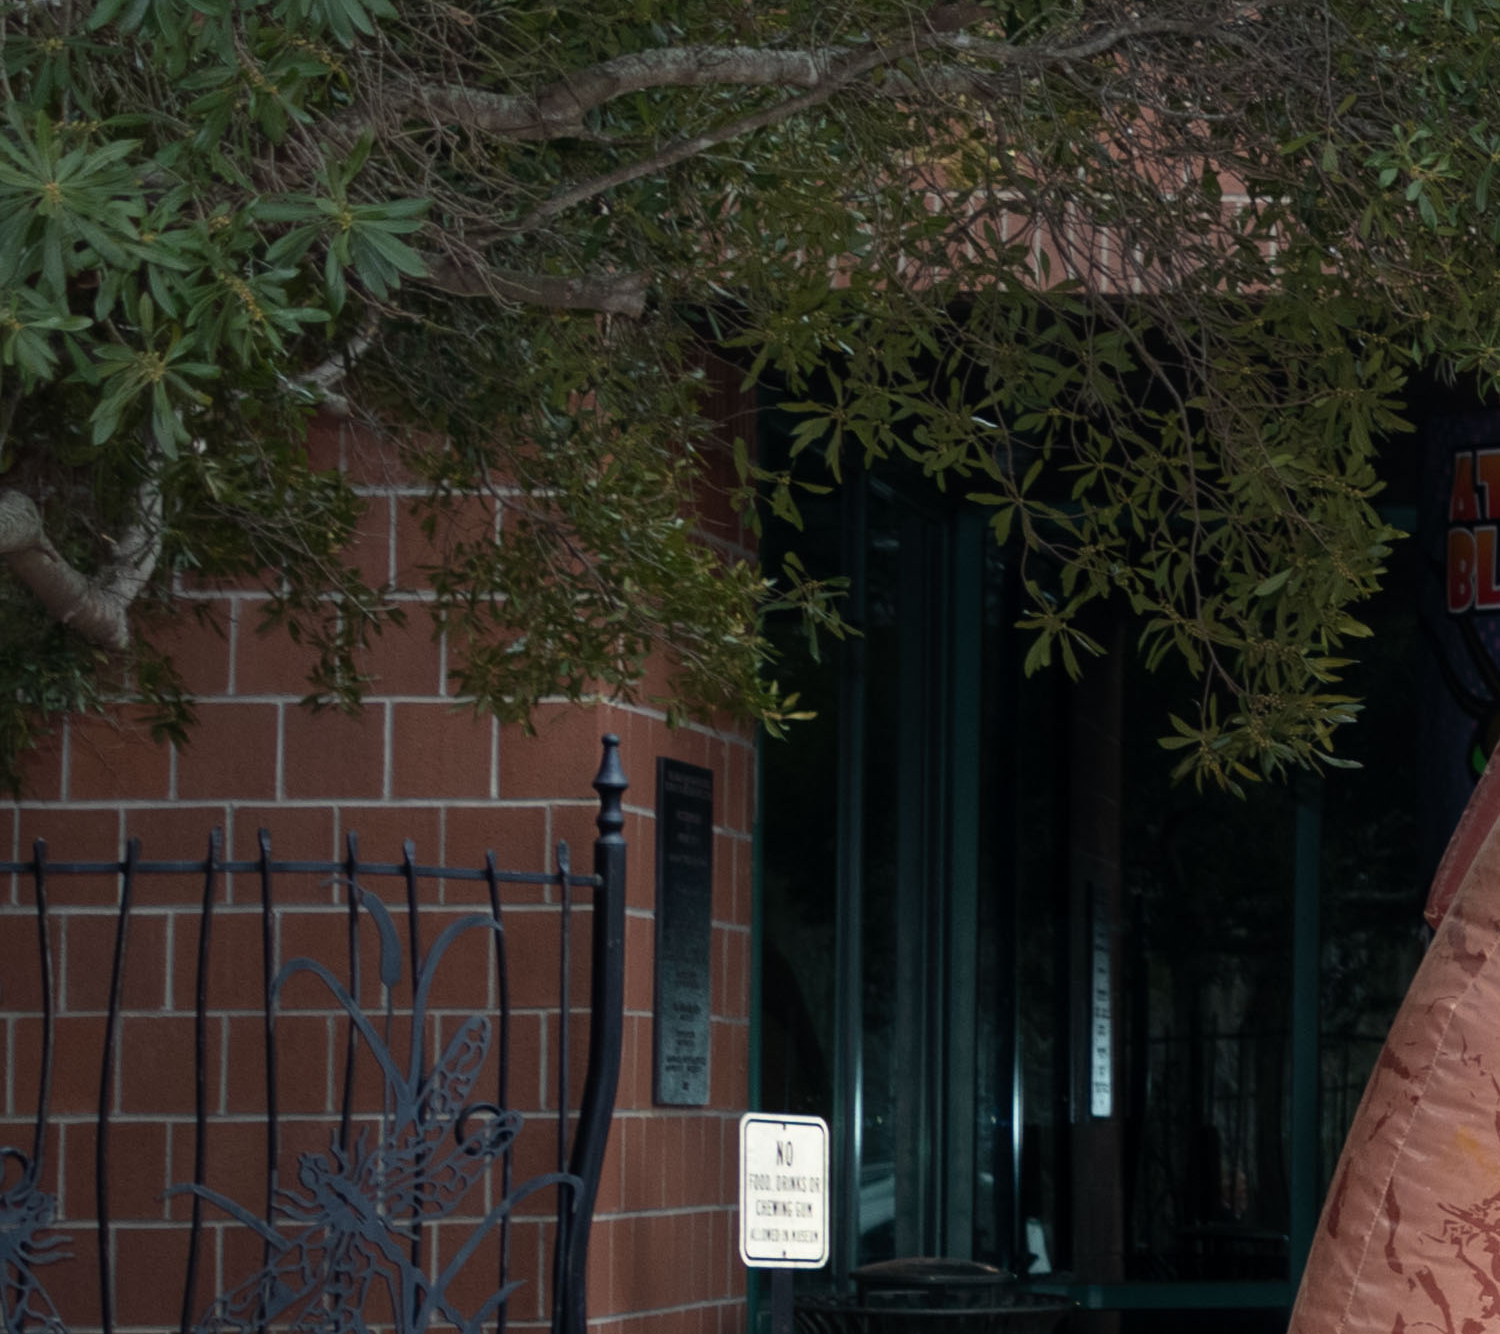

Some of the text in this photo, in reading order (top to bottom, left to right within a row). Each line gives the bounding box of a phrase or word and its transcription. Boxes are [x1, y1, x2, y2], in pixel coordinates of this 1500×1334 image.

[775, 1140, 794, 1167] NO
[776, 1174, 807, 1193] DRINKS
[809, 1176, 820, 1193] OR
[755, 1198, 813, 1218] CHEWING GUM
